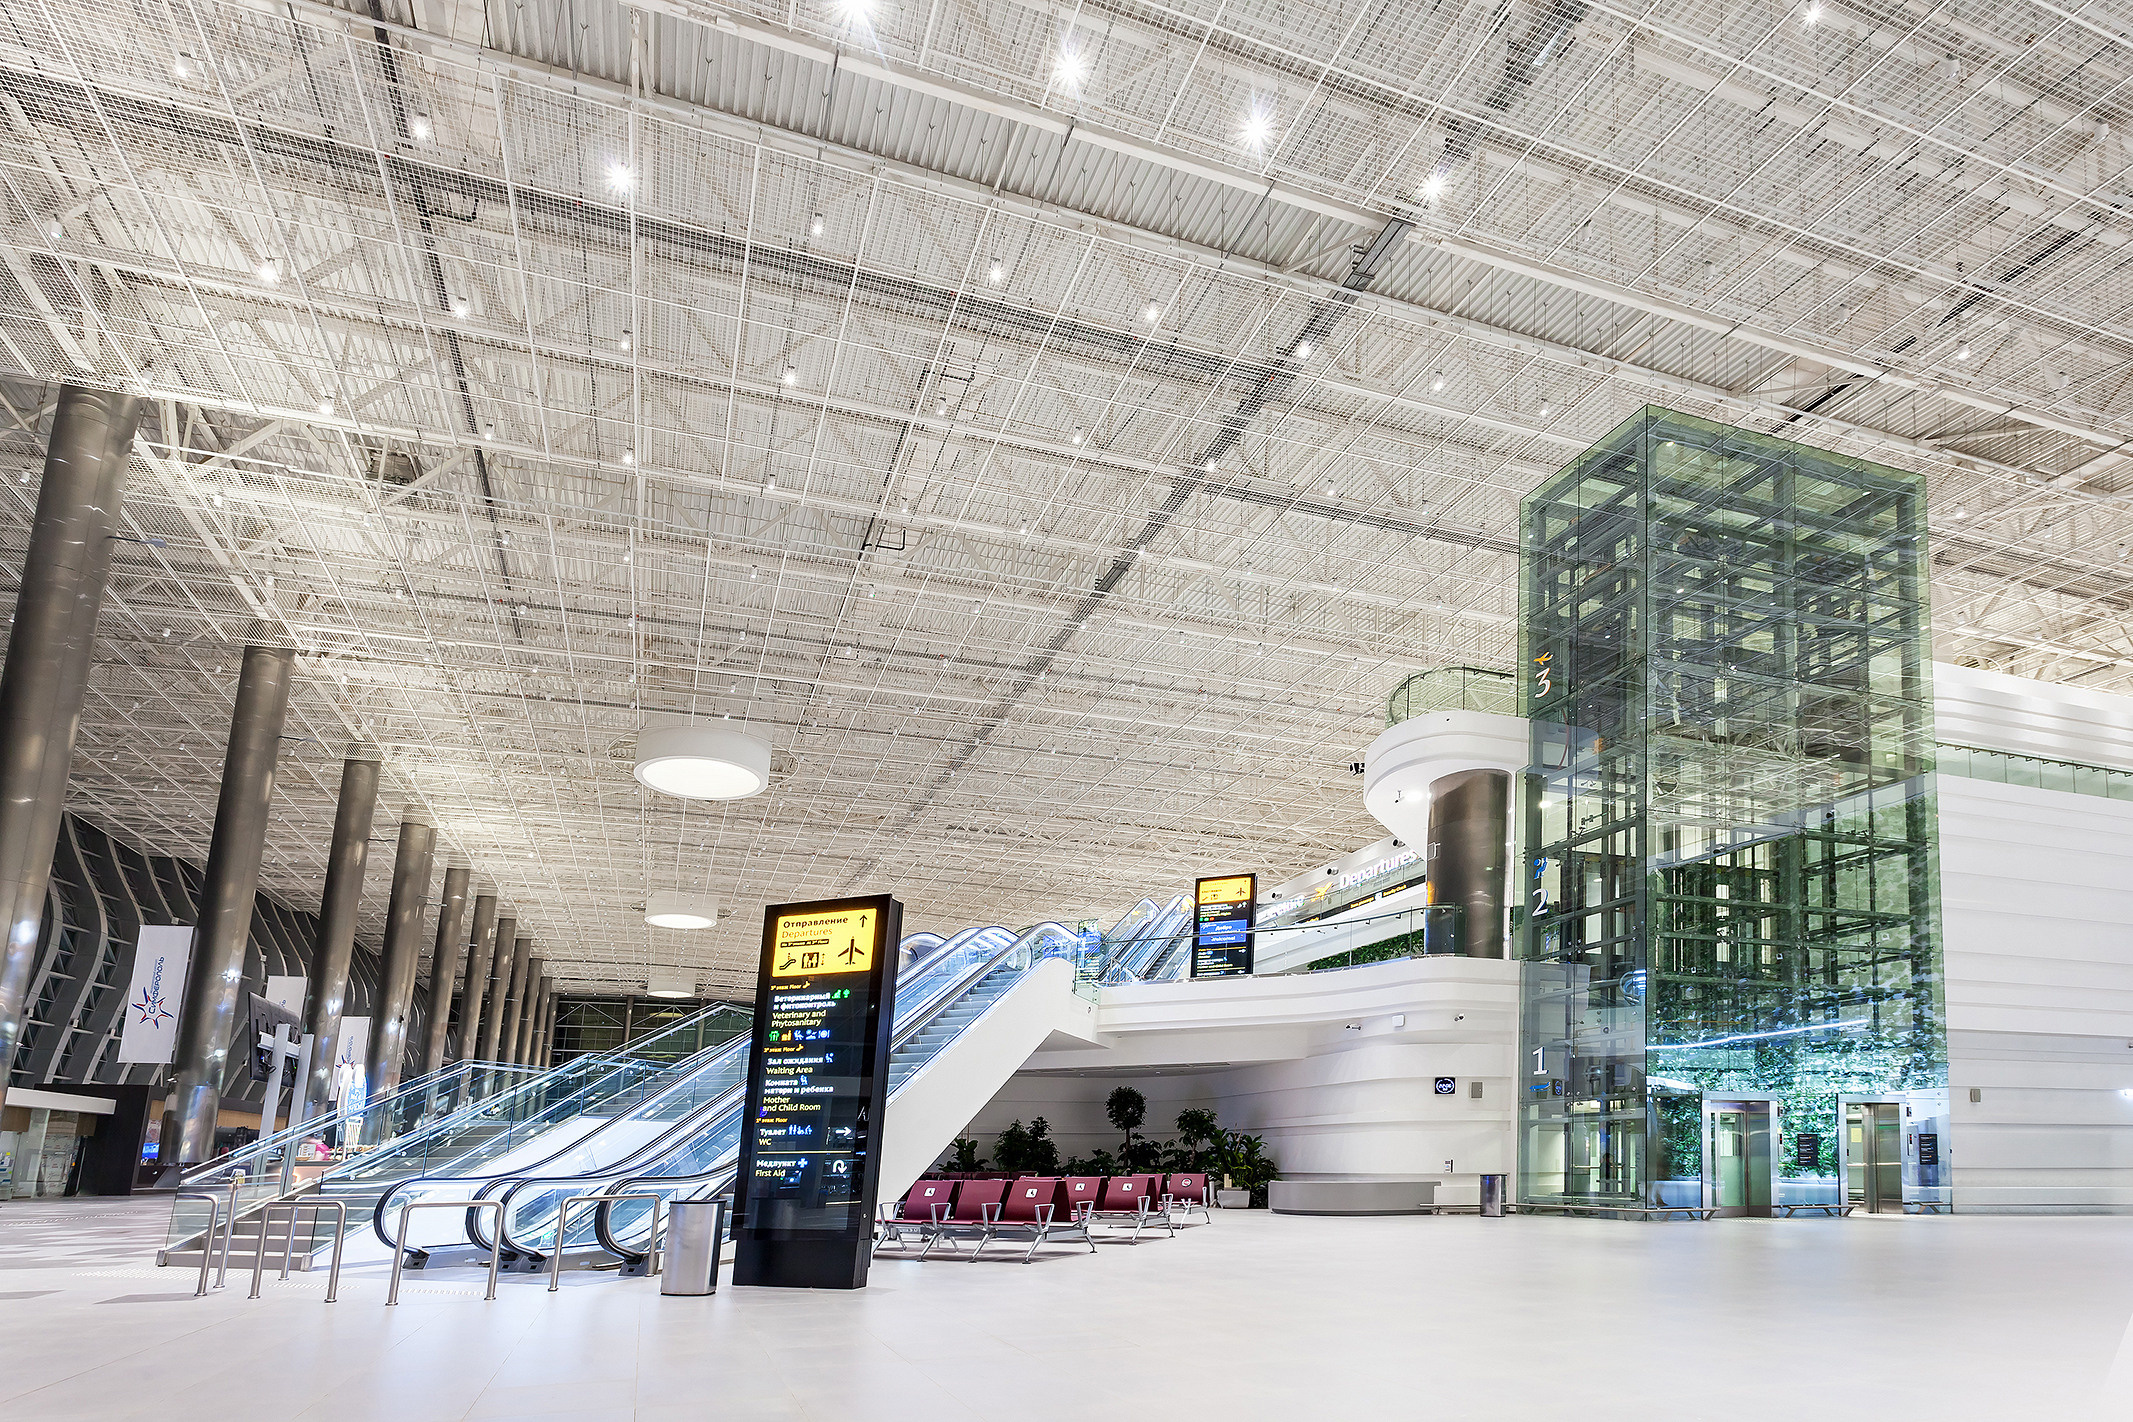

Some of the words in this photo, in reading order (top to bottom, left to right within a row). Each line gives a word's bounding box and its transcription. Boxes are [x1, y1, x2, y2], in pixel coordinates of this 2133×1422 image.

[1534, 667, 1551, 698] 3
[1339, 850, 1419, 889] Departures
[1532, 888, 1550, 917] 2
[783, 917, 848, 928] Отправление
[781, 928, 833, 939] Departures
[772, 1011, 811, 1020] Veterinary
[811, 1009, 827, 1018] and
[771, 1019, 822, 1029] Phytosanitary
[1532, 1046, 1549, 1075] 1
[766, 1067, 795, 1076] Waiting
[795, 1066, 814, 1074] Area
[765, 1079, 799, 1087] Комната
[800, 1085, 834, 1095] ребенка
[763, 1096, 791, 1104] Mother
[762, 1104, 777, 1112] and
[778, 1103, 798, 1112] Child
[760, 1128, 787, 1137] Туалет
[758, 1138, 772, 1146] WC
[756, 1159, 796, 1168] Медпункт
[755, 1169, 772, 1177] First
[772, 1169, 786, 1177] Aid
